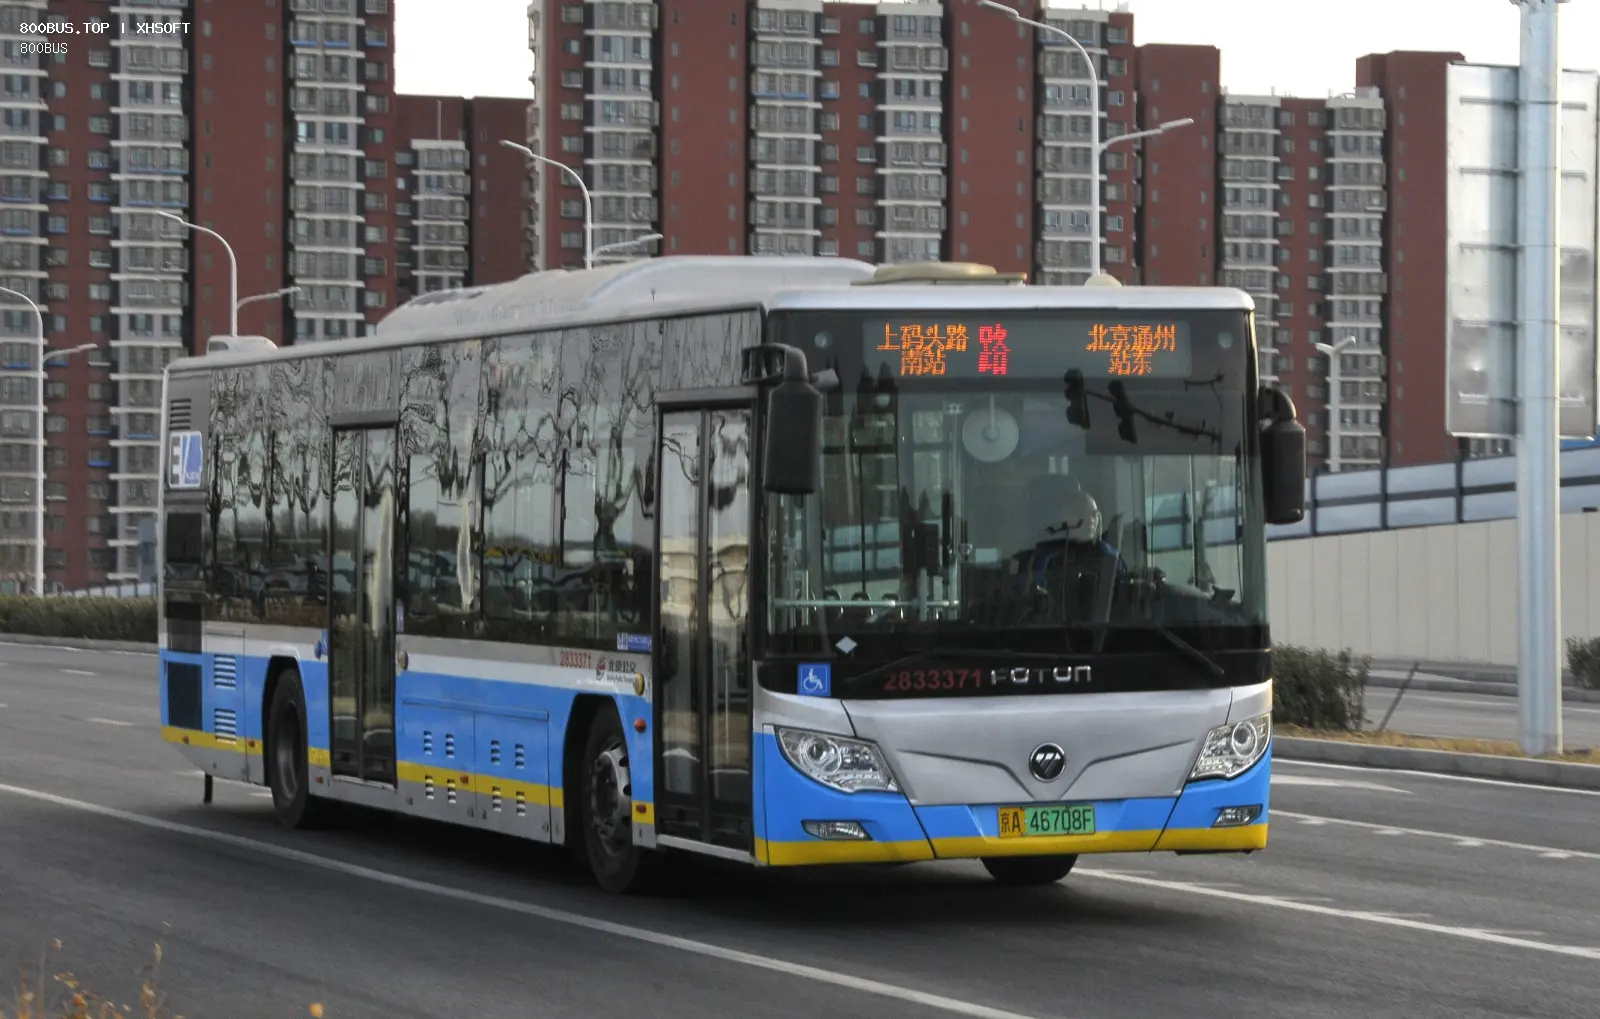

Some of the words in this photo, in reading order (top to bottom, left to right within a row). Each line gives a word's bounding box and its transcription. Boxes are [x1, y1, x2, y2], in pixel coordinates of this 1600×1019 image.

[876, 323, 969, 352] 上码头路
[1085, 323, 1177, 352] 北京通州
[900, 348, 947, 376] 南站
[1107, 349, 1153, 376] 站东
[560, 650, 592, 669] 2833371
[883, 669, 983, 691] 2833371
[999, 811, 1022, 833] 京A
[1029, 808, 1093, 832] 46708F
